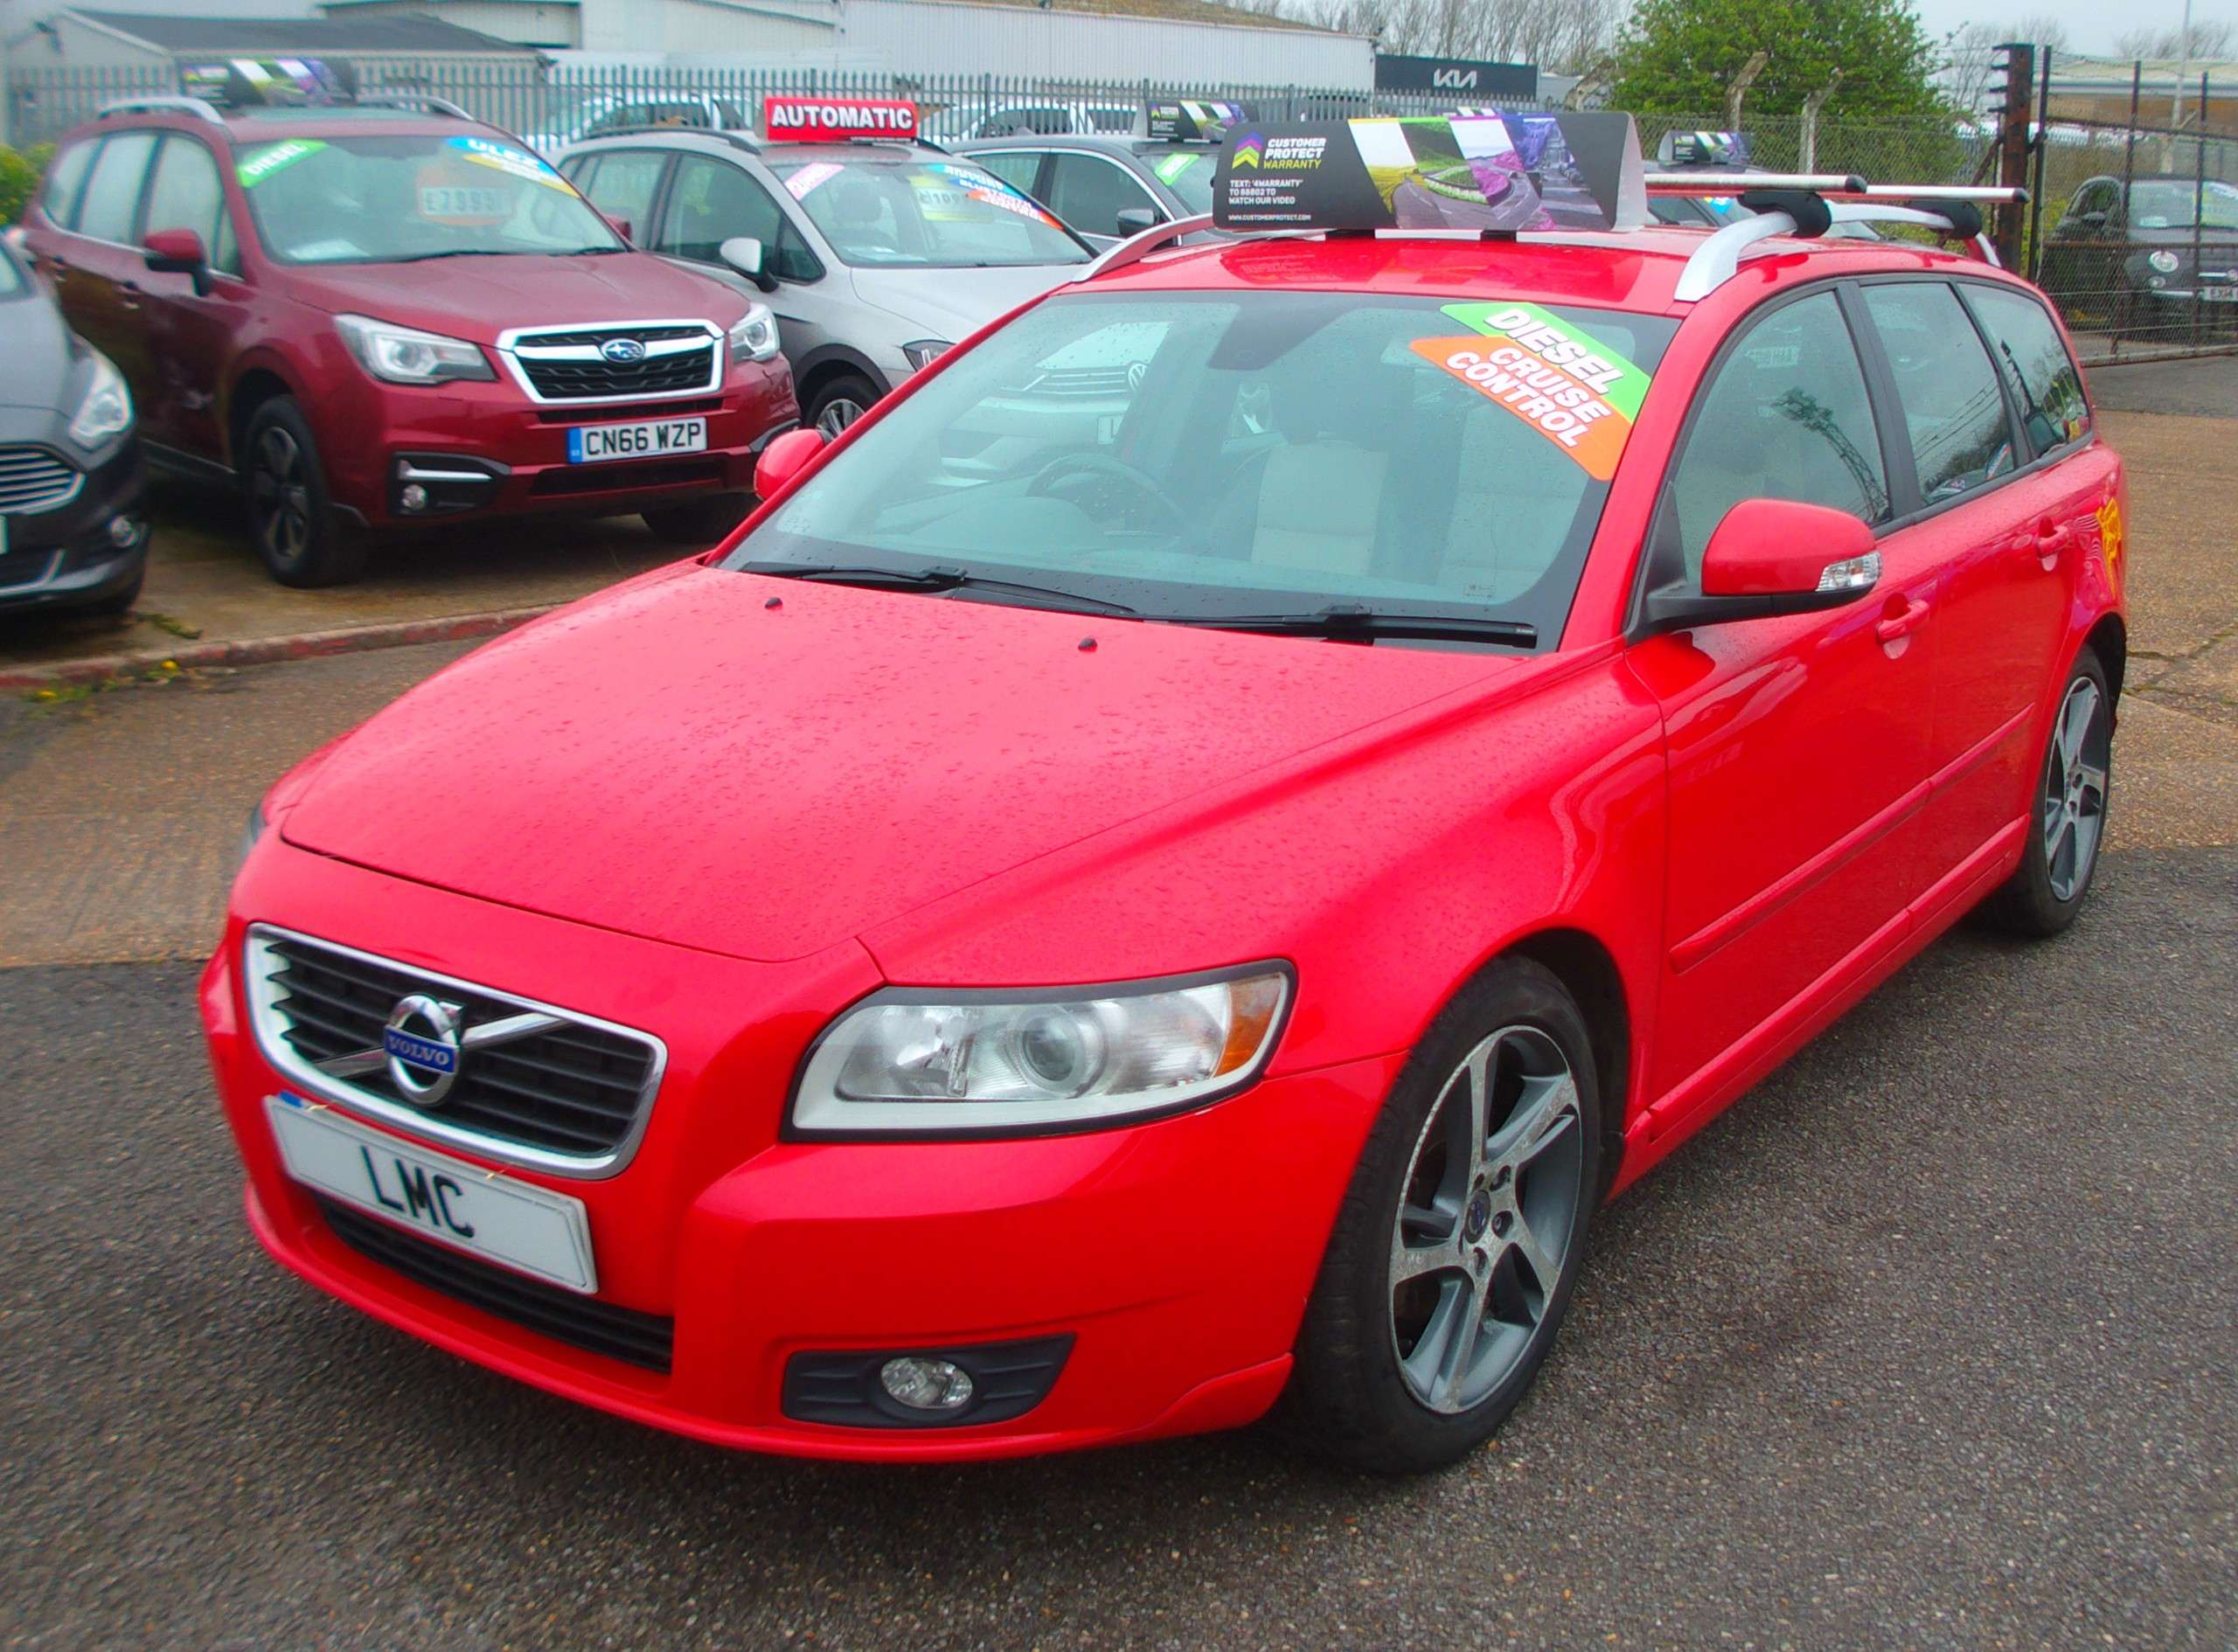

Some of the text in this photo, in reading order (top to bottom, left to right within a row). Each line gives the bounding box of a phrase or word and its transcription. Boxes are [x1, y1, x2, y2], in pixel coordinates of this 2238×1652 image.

[1433, 68, 1477, 88] KIA
[771, 104, 914, 130] AUTOMATIC
[1264, 147, 1324, 159] PROTECT
[1267, 137, 1326, 148] CUSTOMER
[1263, 158, 1322, 170] WARRANTY
[1230, 179, 1251, 188] TEXT:
[1272, 196, 1296, 205] VIDEO
[1484, 309, 1623, 394] DIESEL
[1489, 347, 1611, 423] CRUISE
[1446, 351, 1588, 448] CONTROL
[585, 422, 700, 455] CN66 WZP
[388, 1035, 450, 1065] VOLVO
[359, 1145, 475, 1239] LMC
